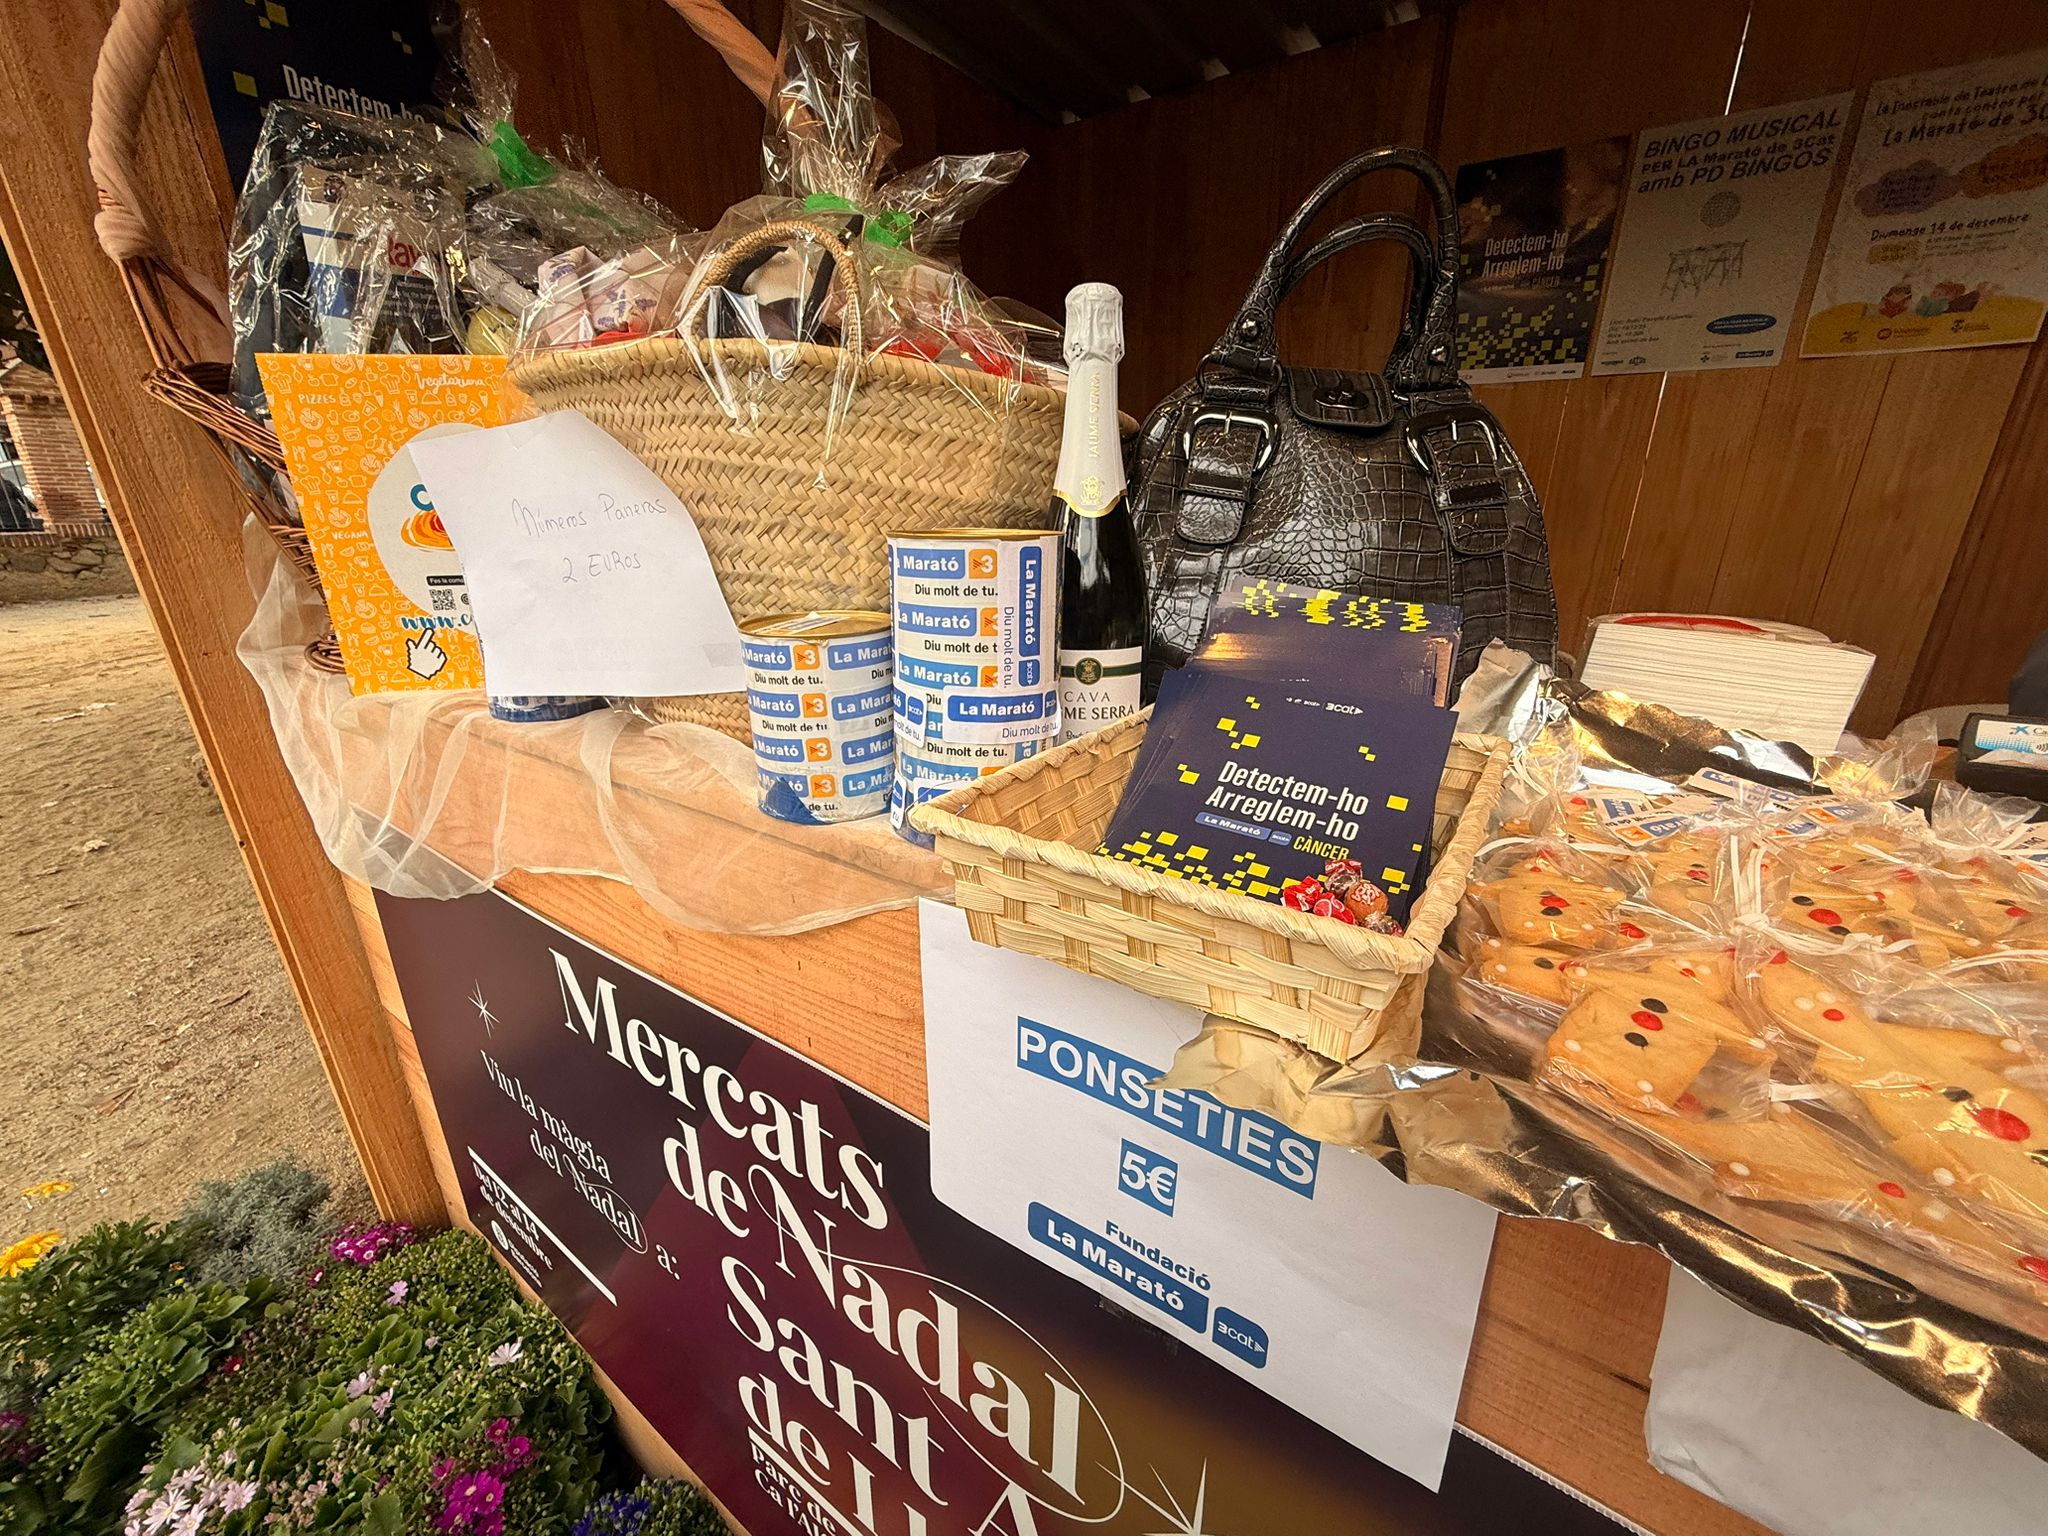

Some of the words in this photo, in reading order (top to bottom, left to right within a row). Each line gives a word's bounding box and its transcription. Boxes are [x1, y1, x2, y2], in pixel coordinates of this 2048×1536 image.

[1643, 130, 1722, 159] BINGO
[1726, 108, 1841, 144] MUSICAL
[1882, 128, 1903, 147] La
[1988, 113, 2014, 128] de
[1641, 159, 1673, 175] PER
[1677, 154, 1699, 169] LA
[1703, 144, 1762, 164] Marató
[1766, 141, 1788, 154] de
[1637, 171, 1685, 194] amb
[1690, 165, 1724, 186] PD
[1729, 148, 1833, 180] BINGOS
[1870, 226, 1926, 242] Diumenge
[1929, 221, 1946, 235] 14
[1949, 221, 1964, 232] de
[1966, 213, 2030, 229] desembre
[1484, 228, 1570, 258] Detectem-ho
[1480, 251, 1566, 280] Arreglem-ho
[299, 393, 336, 405] PIZZES
[331, 529, 369, 540] VEGANA
[562, 557, 578, 583] 2
[903, 555, 960, 573] Marató
[1025, 559, 1037, 580] La
[914, 583, 931, 596] Diu
[933, 584, 960, 597] molt
[963, 585, 979, 598] de
[912, 610, 971, 629] Marató
[1004, 606, 1015, 626] Diu
[1024, 583, 1037, 645] Marató
[924, 639, 942, 652] Diu
[944, 640, 971, 654] molt
[972, 641, 988, 654] de
[1004, 628, 1015, 656] molt
[833, 650, 853, 664] La
[1004, 657, 1015, 672] de
[755, 672, 767, 684] Diu
[768, 674, 790, 686] molt
[792, 675, 805, 686] de
[871, 667, 884, 680] Diu
[914, 666, 972, 685] Marató
[752, 695, 796, 712] Marató
[1063, 690, 1111, 703] CAVA
[837, 700, 856, 715] La
[959, 702, 981, 716] La
[981, 701, 1036, 716] Marató
[1091, 703, 1135, 720] SERRA
[1325, 701, 1356, 715] 3cat
[762, 719, 775, 731] Diu
[776, 721, 798, 733] molt
[800, 723, 813, 732] de
[874, 715, 887, 728] Diu
[1002, 725, 1018, 739] Diu
[1019, 724, 1041, 737] molt
[759, 741, 800, 758] Marató
[847, 744, 866, 759] La
[926, 742, 943, 755] Diu
[946, 744, 972, 758] molt
[974, 747, 990, 758] de
[992, 747, 1008, 757] tu.
[848, 778, 867, 791] La
[1217, 760, 1370, 816] Detectem-ho
[808, 803, 823, 812] de
[1204, 786, 1361, 842] Arreglem-ho
[1203, 815, 1218, 825] La
[1218, 818, 1261, 836] Marató
[1292, 834, 1350, 861] CÀNCER
[548, 946, 889, 1231] Mercats
[481, 1048, 518, 1102] Viu
[514, 1077, 539, 1121] la
[539, 1106, 614, 1184] màgia
[1019, 1025, 1316, 1187] PONSETIES
[1119, 1152, 1177, 1207] 5€
[492, 1180, 509, 1209] 12
[522, 1212, 540, 1241] 14
[529, 1127, 564, 1178] del
[561, 1153, 645, 1249] Nadal
[655, 1243, 681, 1281] a:
[480, 1184, 495, 1207] de
[494, 1200, 554, 1270] desembre
[1105, 1219, 1212, 1293] Fundació
[1046, 1217, 1076, 1249] La
[1081, 1240, 1185, 1313] Marató
[1216, 1319, 1254, 1352] 3cat
[662, 1117, 750, 1238] de
[747, 1163, 1086, 1505] Nadal
[720, 1254, 949, 1506] Sant
[737, 1372, 832, 1487] de
[750, 1441, 802, 1504] Parc
[806, 1501, 837, 1536] de
[754, 1468, 784, 1508] Ca
